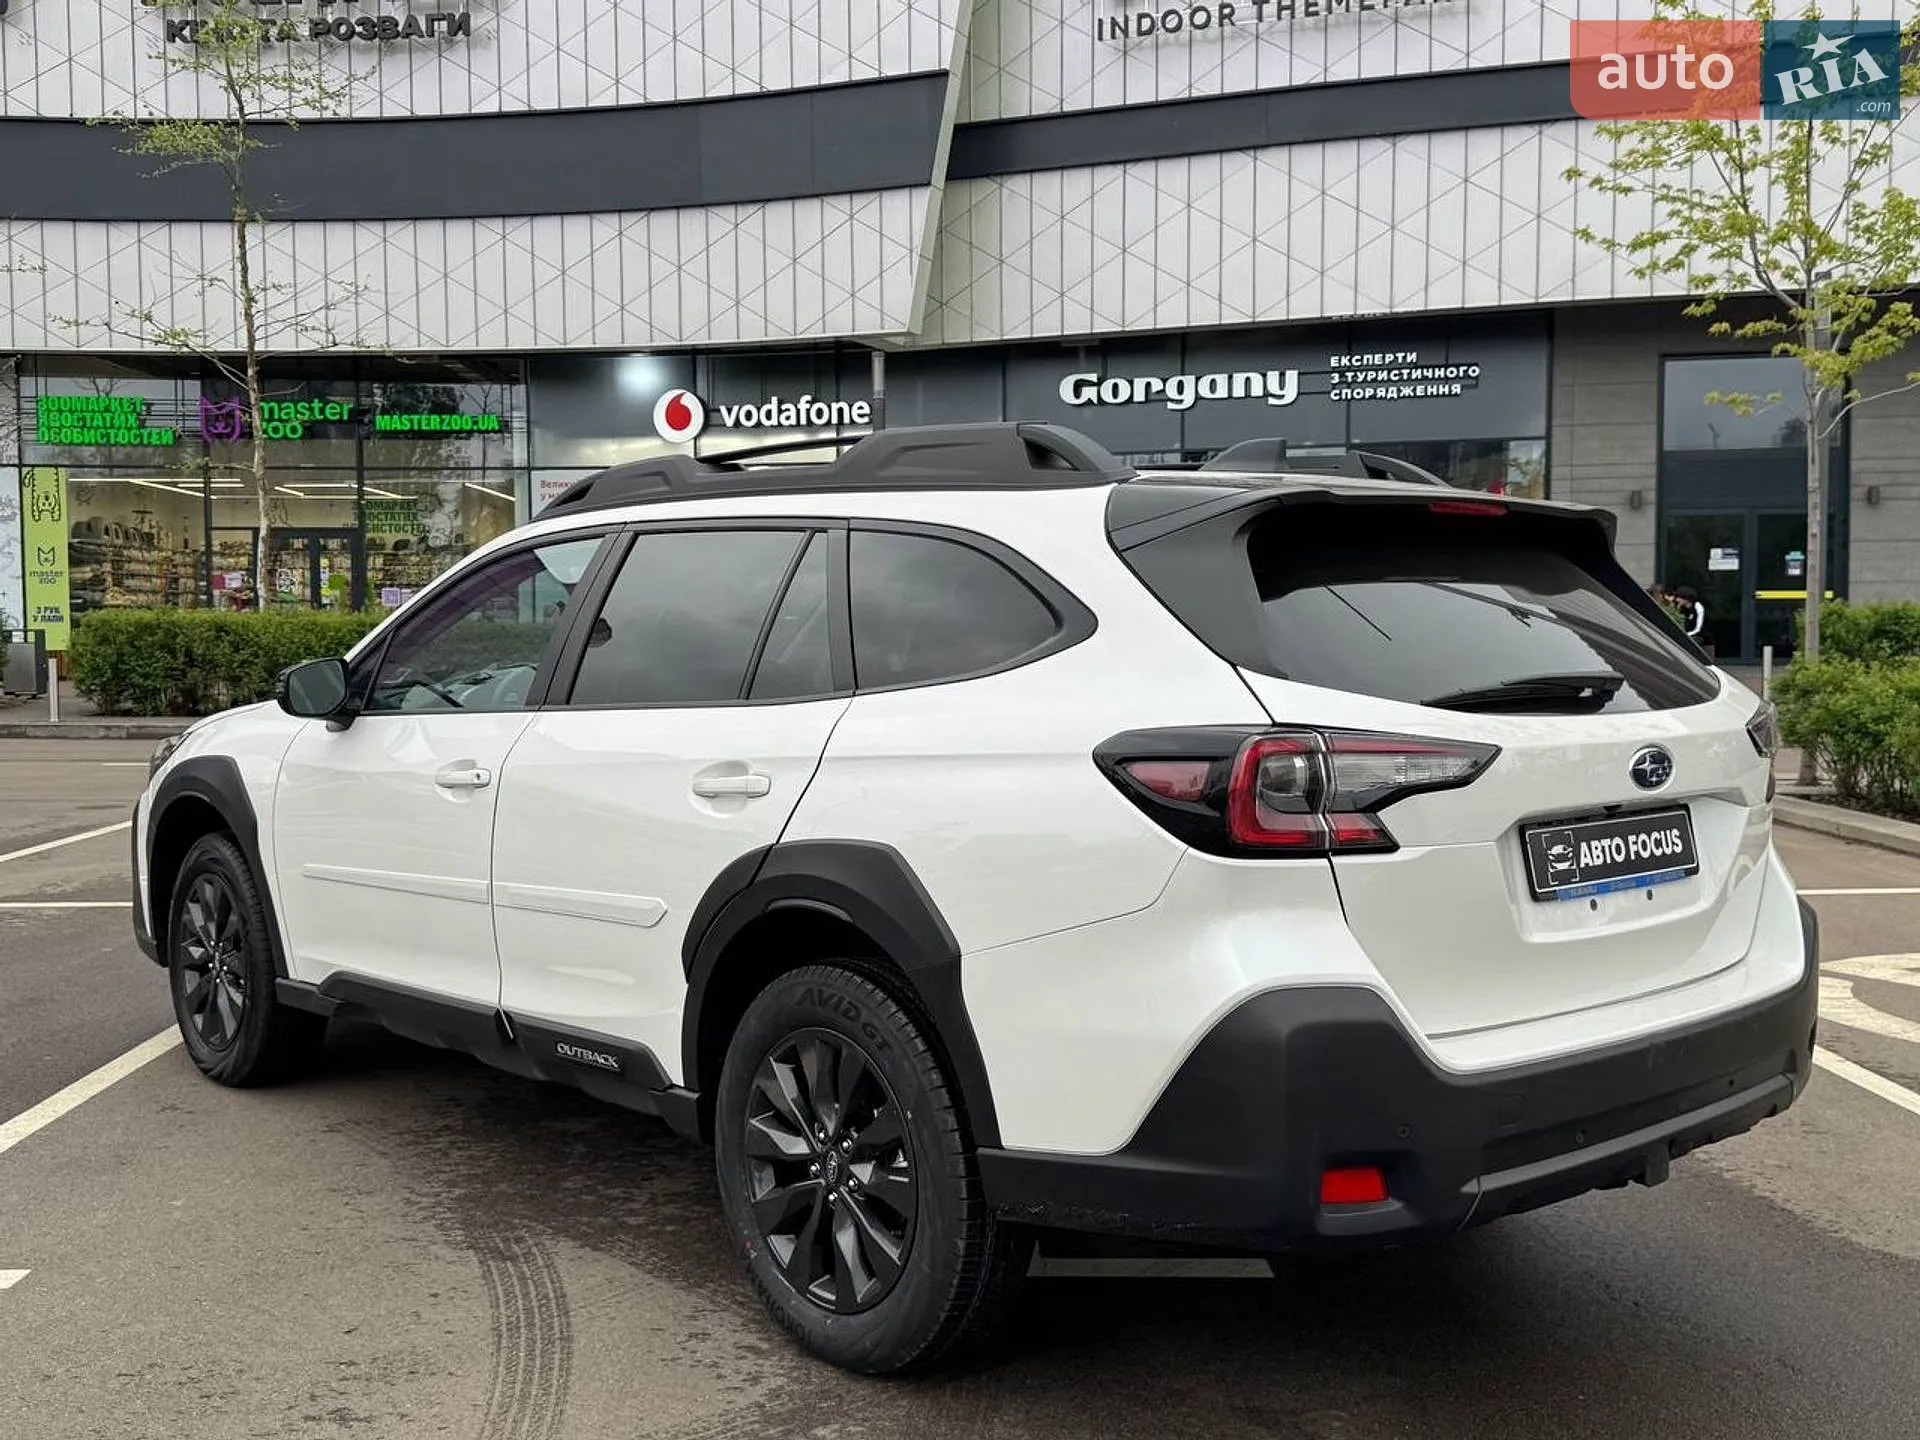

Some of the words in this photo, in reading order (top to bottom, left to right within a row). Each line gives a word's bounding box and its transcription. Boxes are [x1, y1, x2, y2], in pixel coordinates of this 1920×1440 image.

[309, 12, 471, 41] РОЗВАГИ
[1097, 3, 1235, 41] INDOOR
[1330, 352, 1417, 367] ЕКСПЕРТИ
[1345, 366, 1480, 383] ТУРИСТИЧНОГО
[1059, 370, 1299, 410] Gorgany
[1330, 384, 1461, 400] СПОРЯДЖЕННЯ
[375, 414, 499, 431] MASTERZOO.UA
[719, 394, 871, 427] vodafone
[1627, 828, 1683, 860] FOCUS
[556, 1042, 618, 1068] OUTBACK
